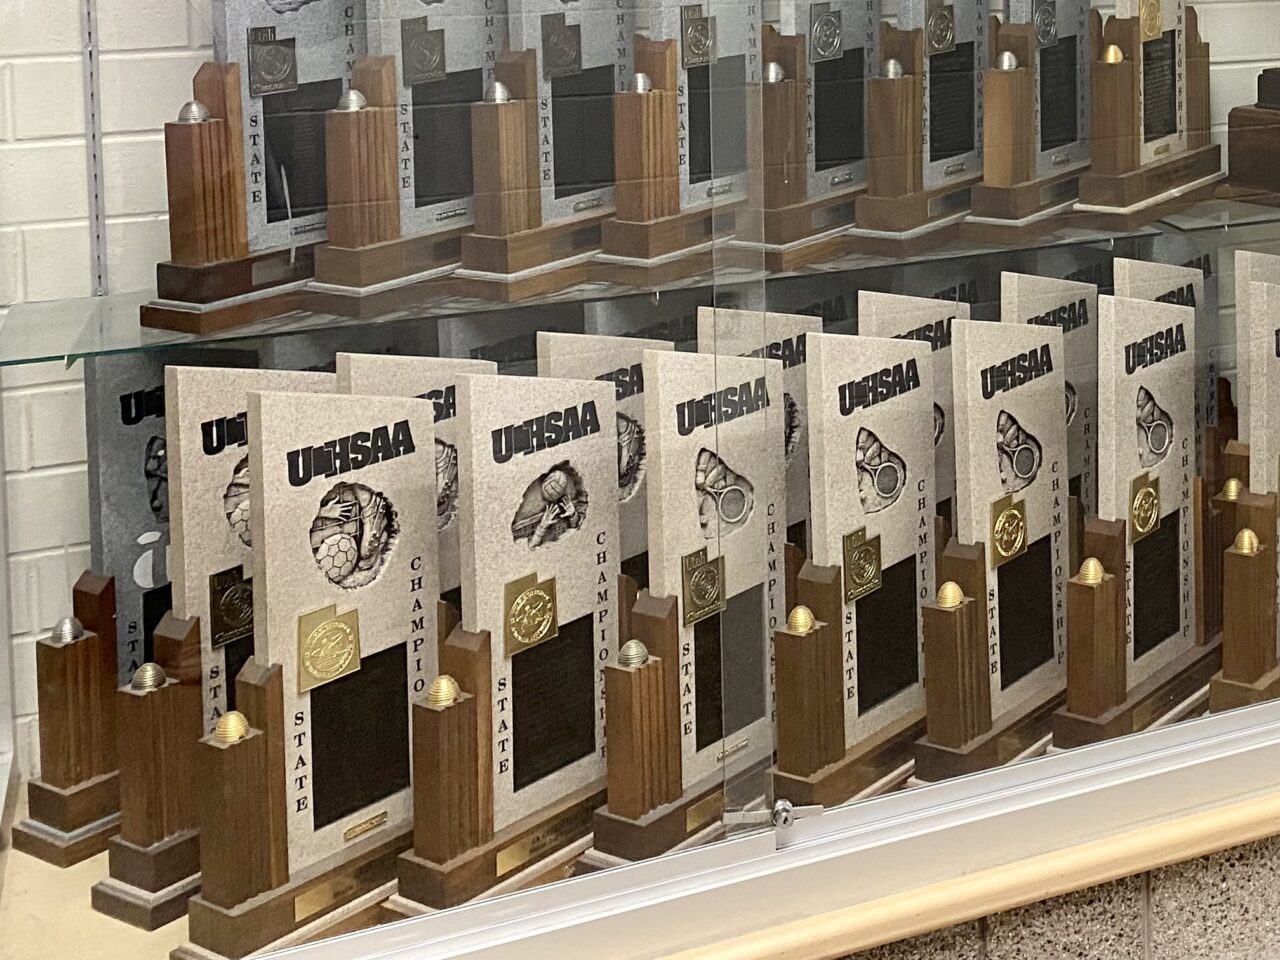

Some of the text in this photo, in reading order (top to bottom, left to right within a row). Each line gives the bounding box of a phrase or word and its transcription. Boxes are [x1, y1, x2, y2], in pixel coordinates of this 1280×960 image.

[249, 114, 262, 203] STATE
[400, 103, 411, 189] STATE
[541, 98, 551, 181] STATE
[678, 85, 686, 166] STATE
[838, 358, 921, 417] UHSAA
[980, 343, 1054, 400] UHSAA
[1124, 323, 1187, 375] UHSAA
[491, 400, 600, 464] UHSAA
[675, 376, 770, 437] UHSAA
[286, 419, 415, 488] UHSAA
[1051, 461, 1065, 665] CHAMPIONSHIP
[1181, 437, 1190, 639] CHAMPIONSHIP
[128, 620, 138, 672] STA
[410, 556, 425, 693] CHAMPIO
[844, 612, 855, 701] STATE
[988, 588, 998, 675] STATE
[209, 664, 223, 732] STA
[497, 676, 509, 775] STATE
[682, 642, 693, 737] STATE
[294, 711, 308, 813] STATE
